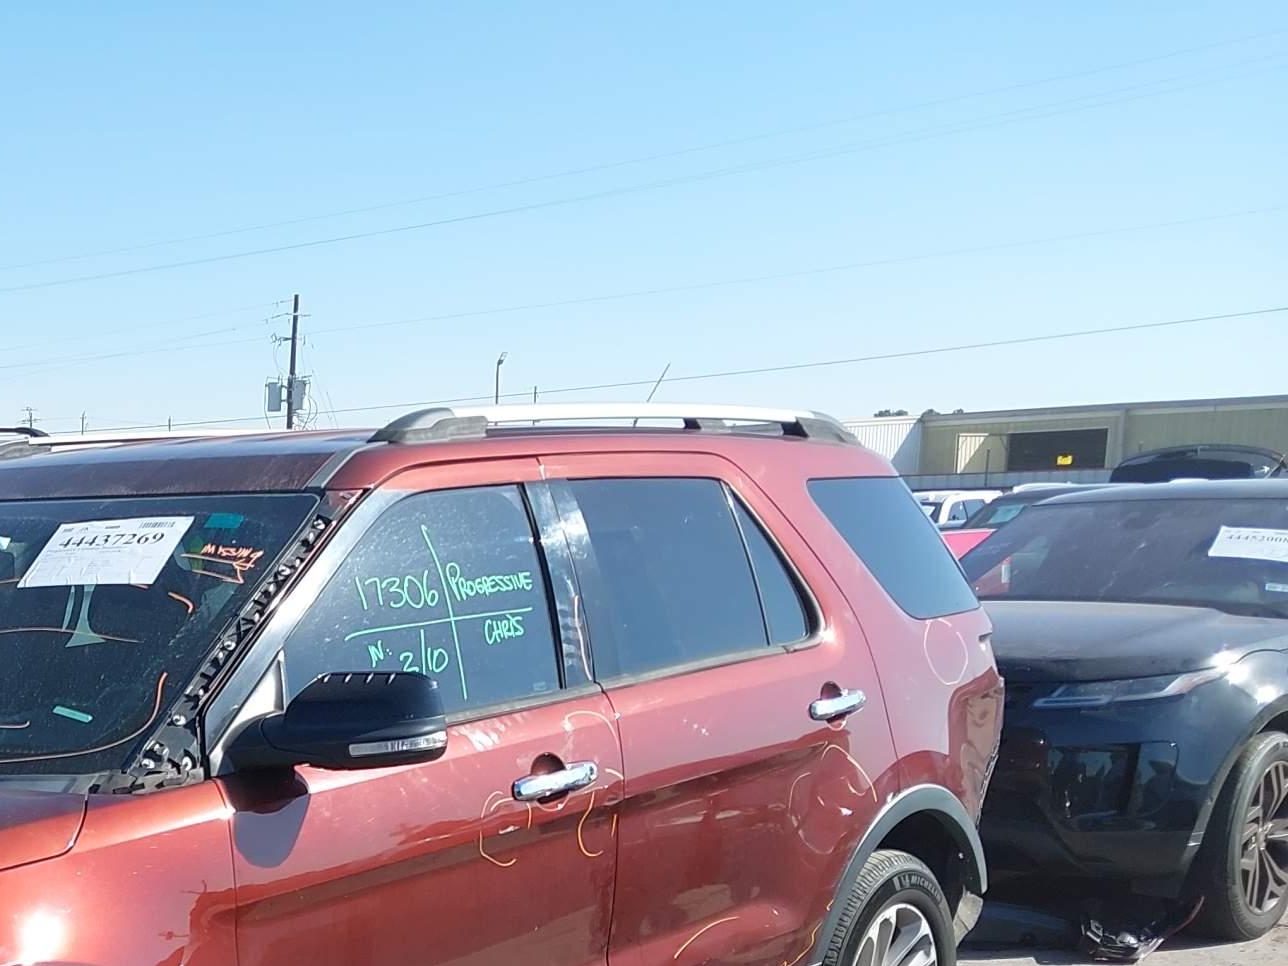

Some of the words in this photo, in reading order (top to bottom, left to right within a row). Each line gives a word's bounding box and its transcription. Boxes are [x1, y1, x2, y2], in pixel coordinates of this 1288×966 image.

[59, 531, 165, 548] 44437269
[355, 569, 439, 610] 17306
[446, 562, 532, 601] PROGRESSIVE
[484, 614, 525, 645] CHRIS
